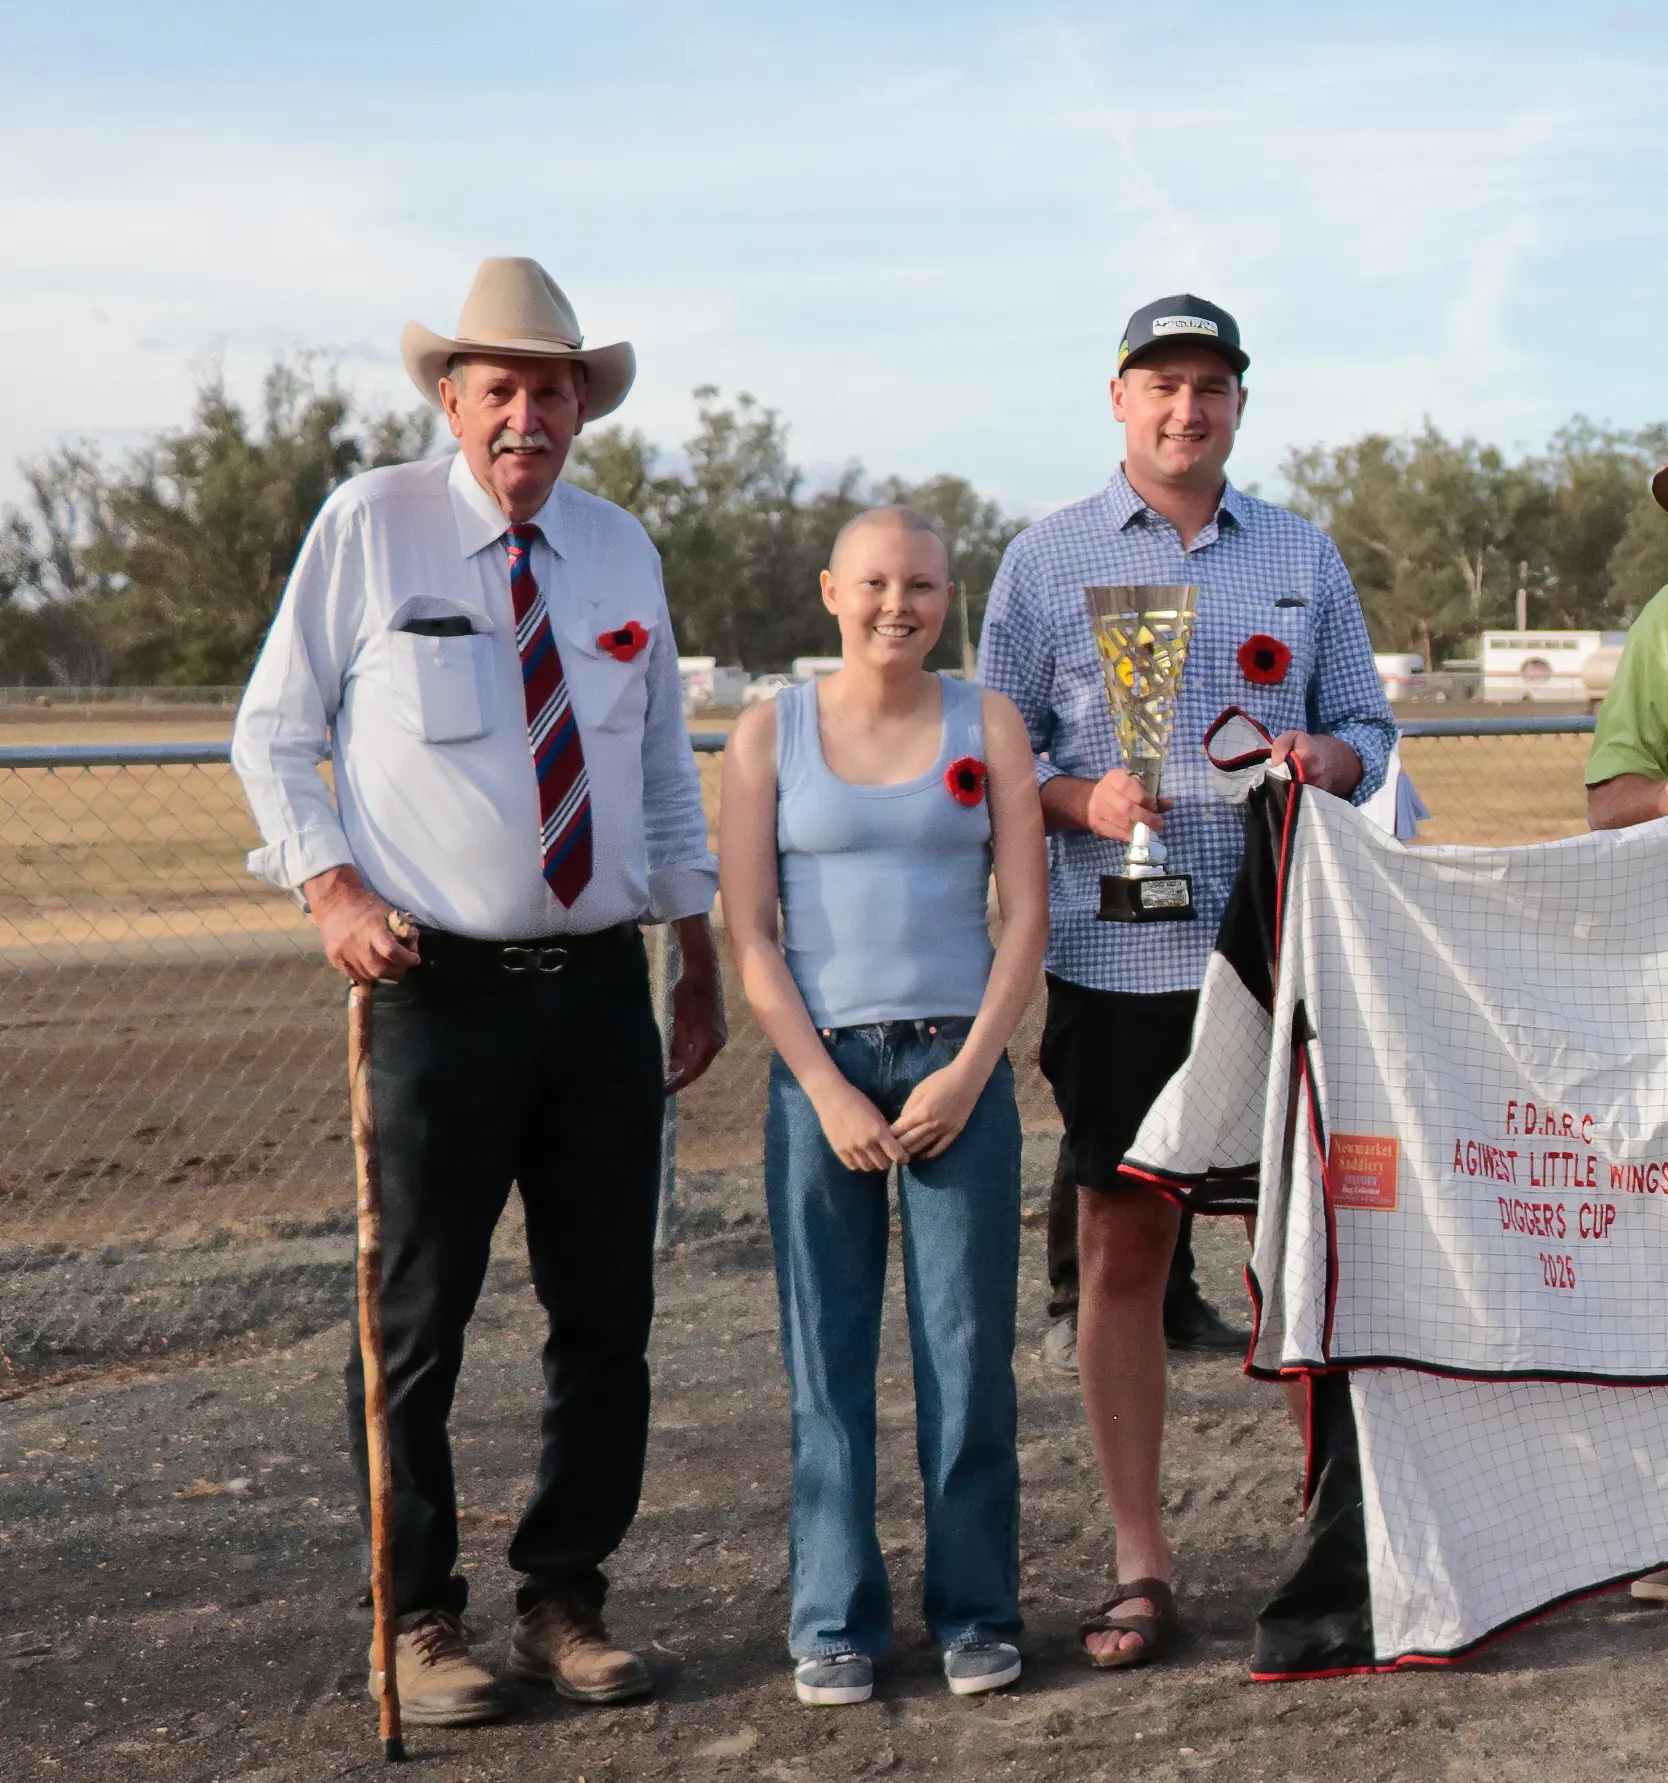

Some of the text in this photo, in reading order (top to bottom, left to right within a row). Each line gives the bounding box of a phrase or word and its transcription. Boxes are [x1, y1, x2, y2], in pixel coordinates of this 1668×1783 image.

[1530, 1151, 1598, 1188] LITTLE
[1498, 1197, 1616, 1239] DIGGERS CUP
[1539, 1251, 1576, 1289] 2026
